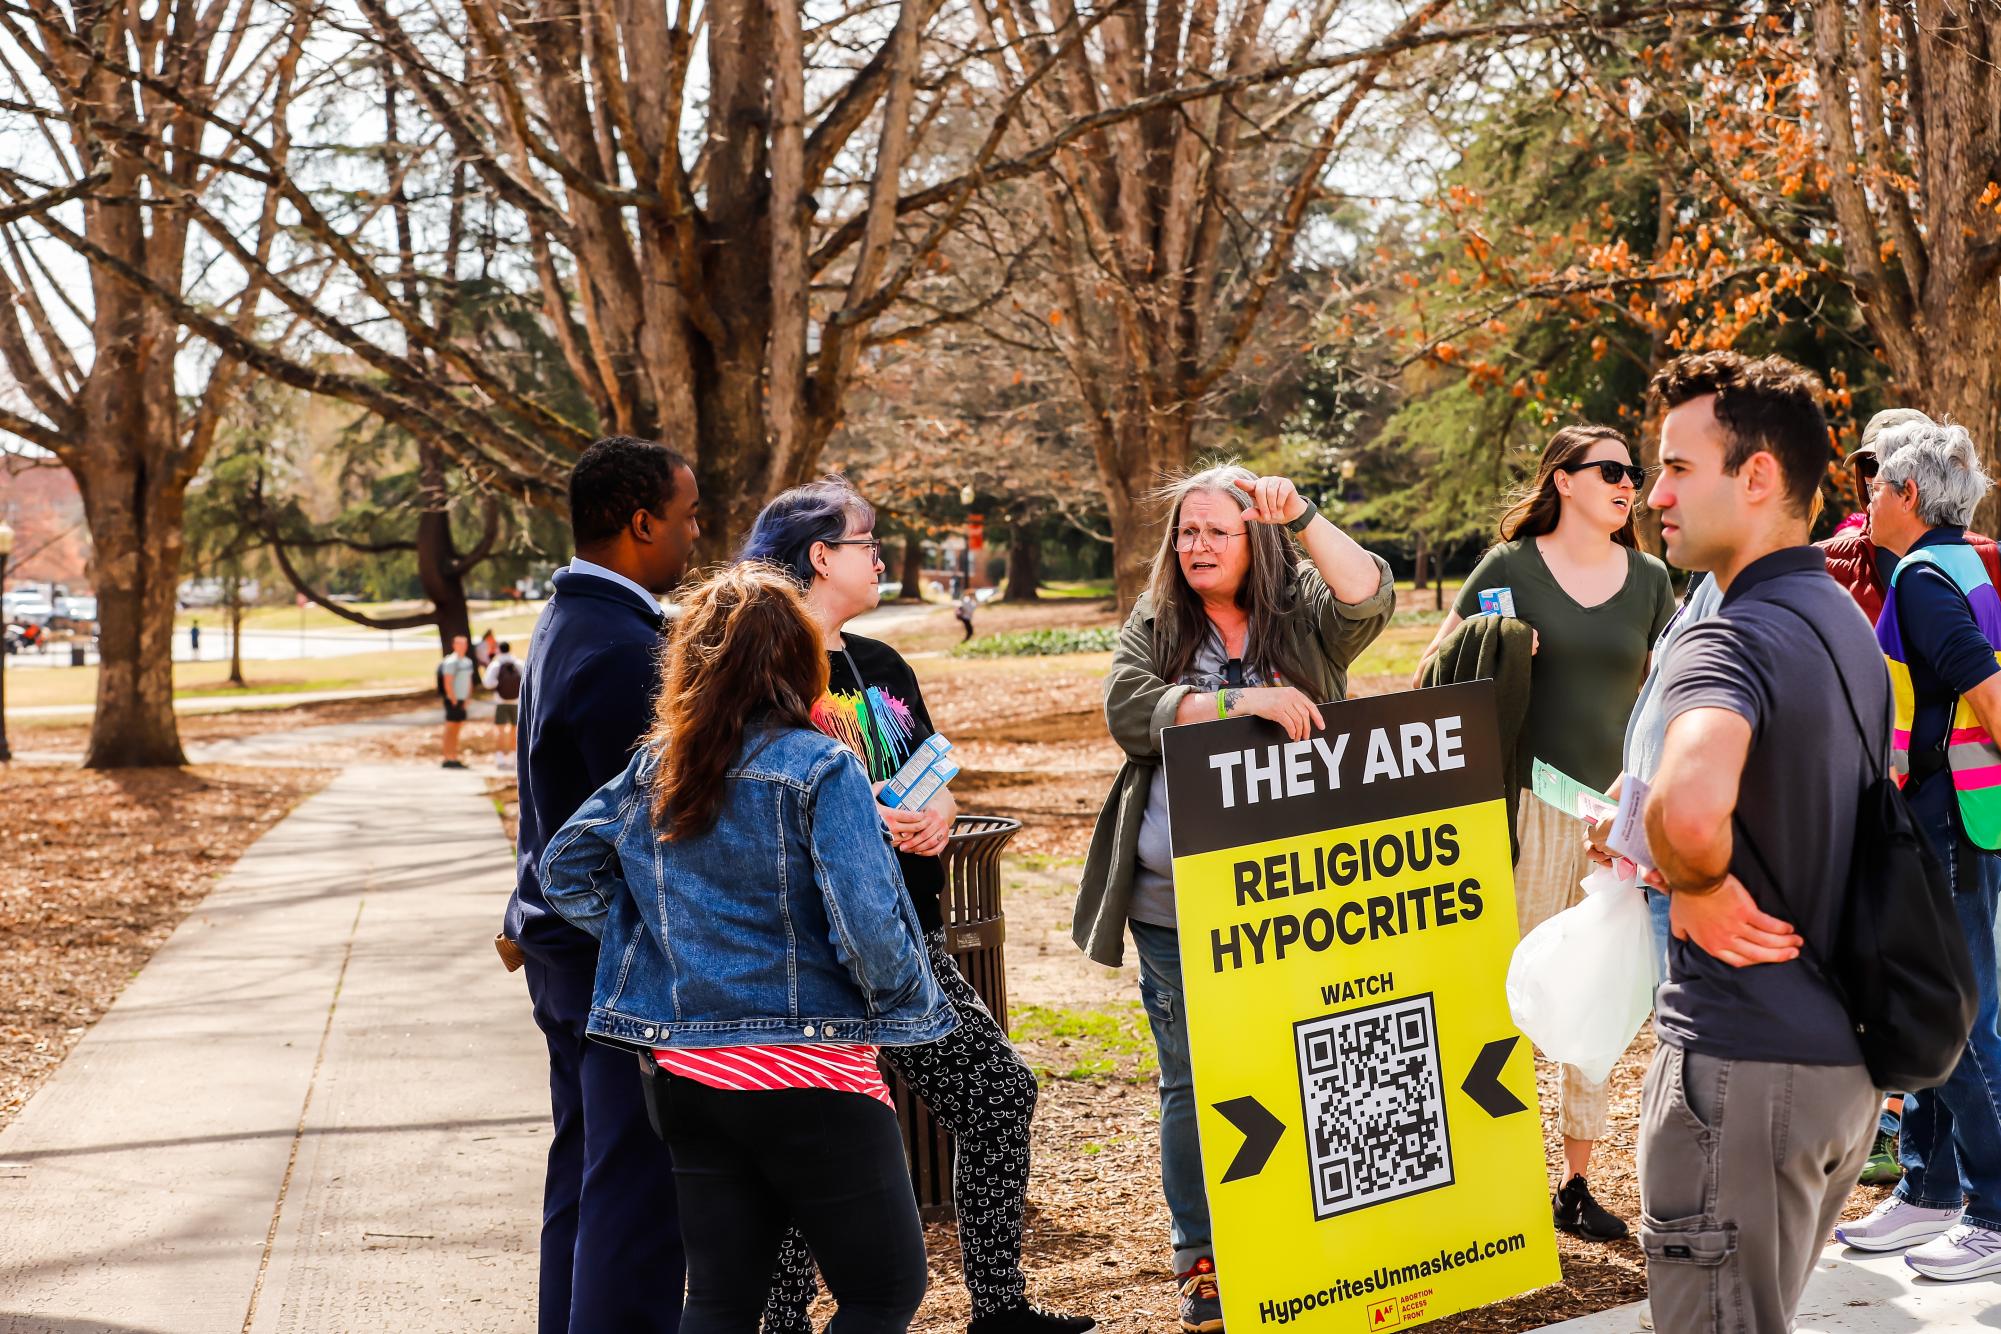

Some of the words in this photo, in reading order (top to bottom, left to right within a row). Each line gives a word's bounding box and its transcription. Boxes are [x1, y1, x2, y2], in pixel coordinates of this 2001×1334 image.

[1209, 733, 1351, 808] THEY
[1363, 715, 1466, 784] ARE
[1233, 823, 1460, 906] RELIGIOUS
[1210, 877, 1484, 973] HYPOCRITES
[1320, 971, 1394, 1006] WATCH
[1259, 1233, 1526, 1325] HypocritesUnmasked.com
[1401, 1288, 1433, 1304] ABORTION
[1402, 1300, 1427, 1312] ACCESS
[1403, 1310, 1424, 1322] FRONT
